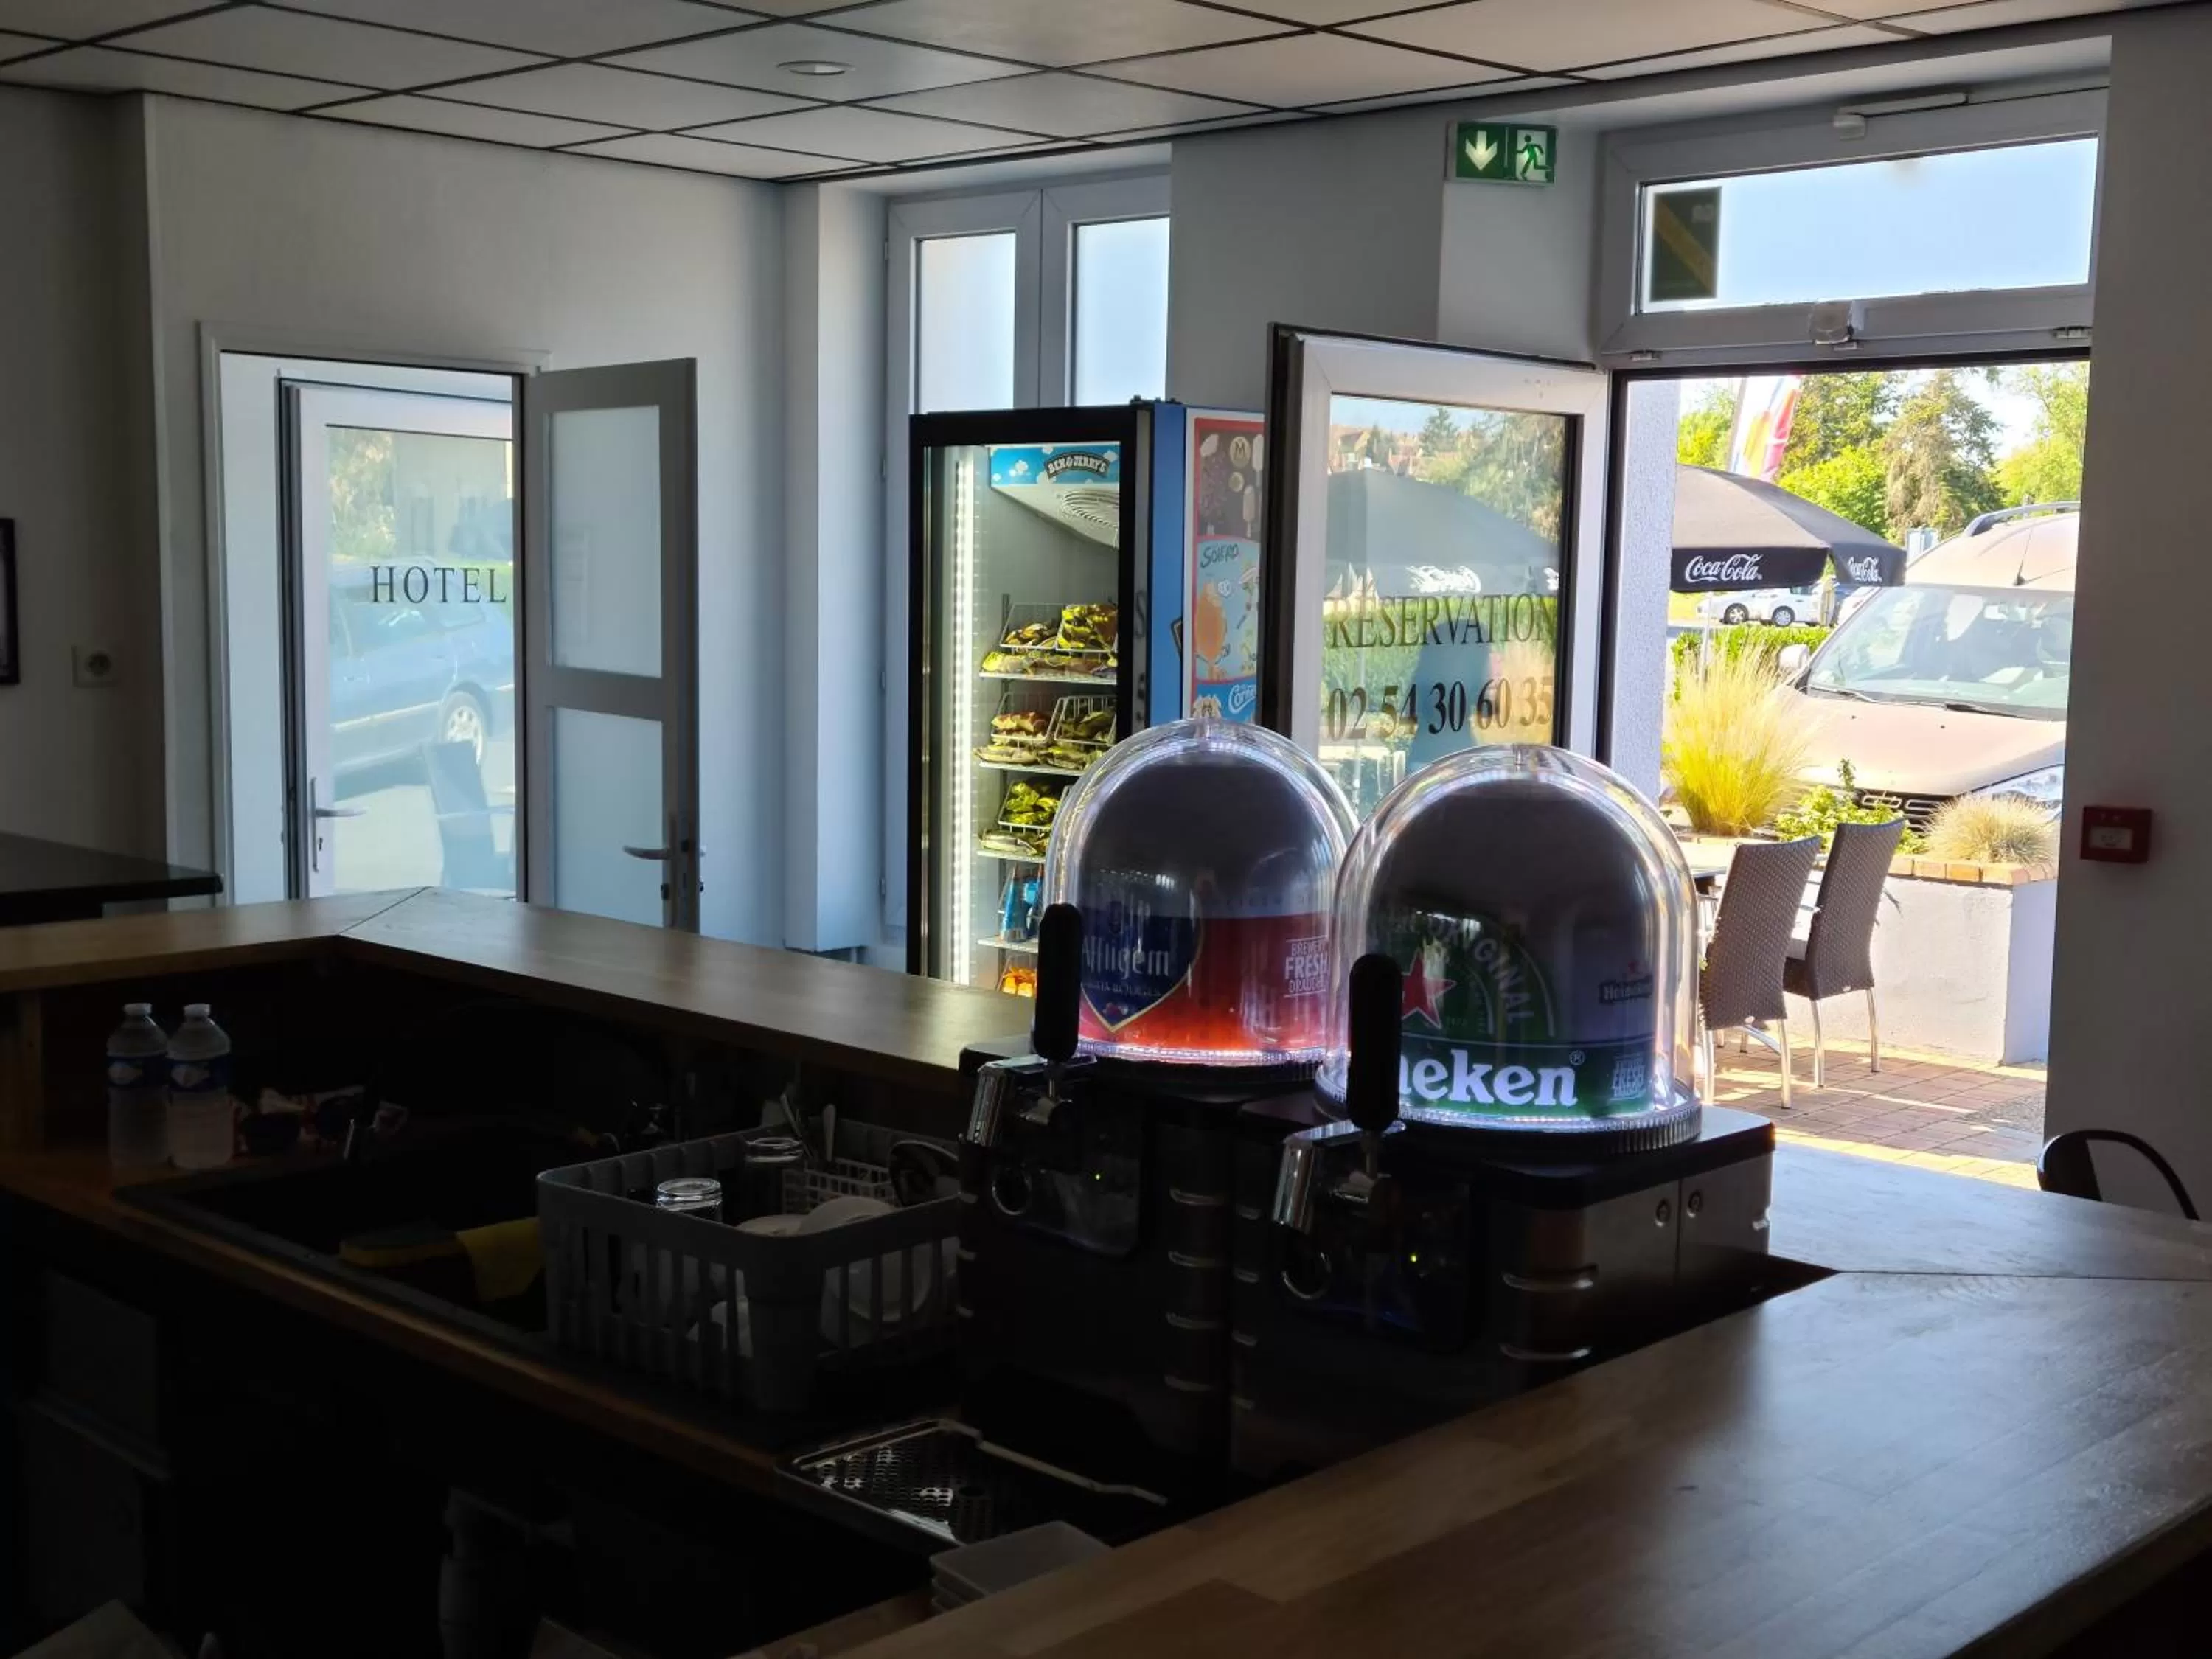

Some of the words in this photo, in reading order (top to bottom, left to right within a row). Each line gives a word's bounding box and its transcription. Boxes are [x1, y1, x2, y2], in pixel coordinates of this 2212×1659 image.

[1048, 458, 1067, 473] BEN
[1073, 455, 1107, 473] JERRY'S
[370, 566, 507, 603] HOTEL
[1685, 554, 1763, 583] Coca-Cola
[1328, 687, 1367, 740] 02
[1379, 684, 1418, 737] 54
[1428, 681, 1467, 735] 30
[1476, 678, 1512, 730] 60
[1519, 676, 1554, 727] 35
[1285, 953, 1328, 980] FRESH
[1400, 1049, 1579, 1106] eken
